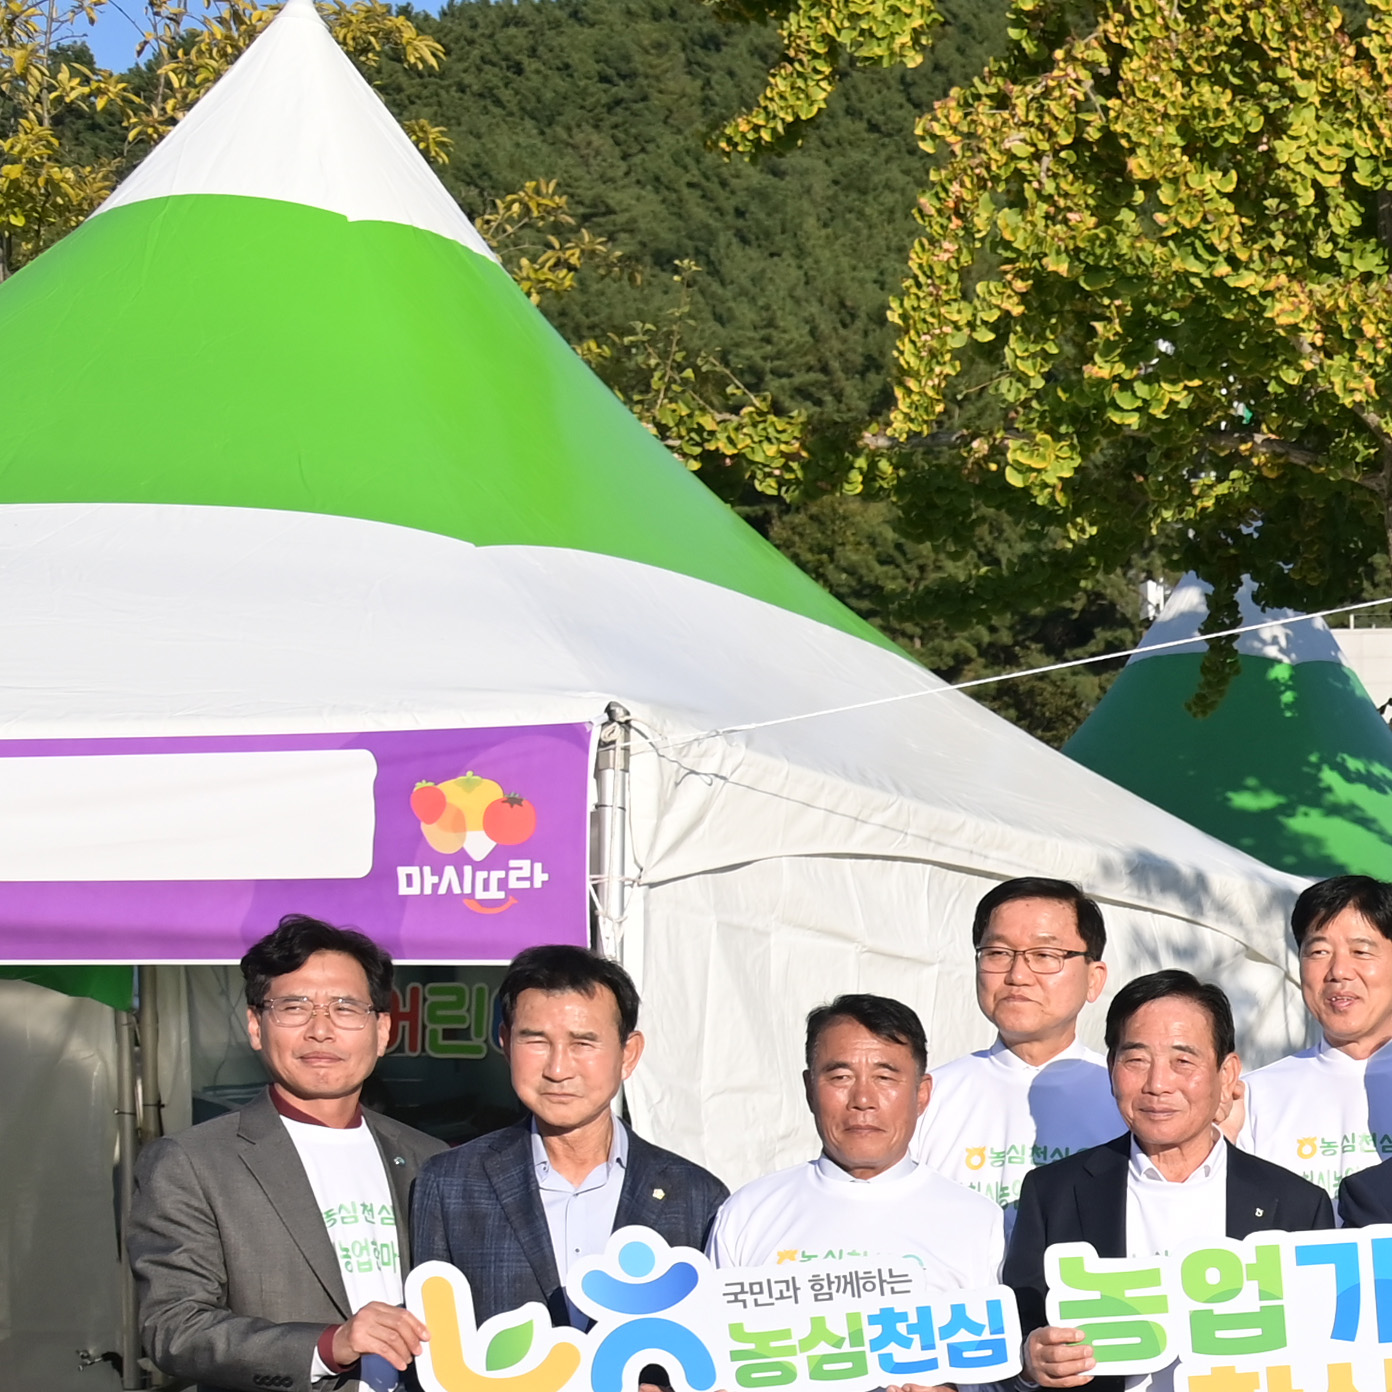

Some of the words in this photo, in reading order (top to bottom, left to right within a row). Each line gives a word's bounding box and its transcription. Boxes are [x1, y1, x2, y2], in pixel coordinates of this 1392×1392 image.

[722, 1275, 802, 1310] 국민과
[807, 1267, 913, 1303] 함께하는
[1058, 1244, 1288, 1363] 농업
[728, 1298, 1009, 1389] 농심천심
